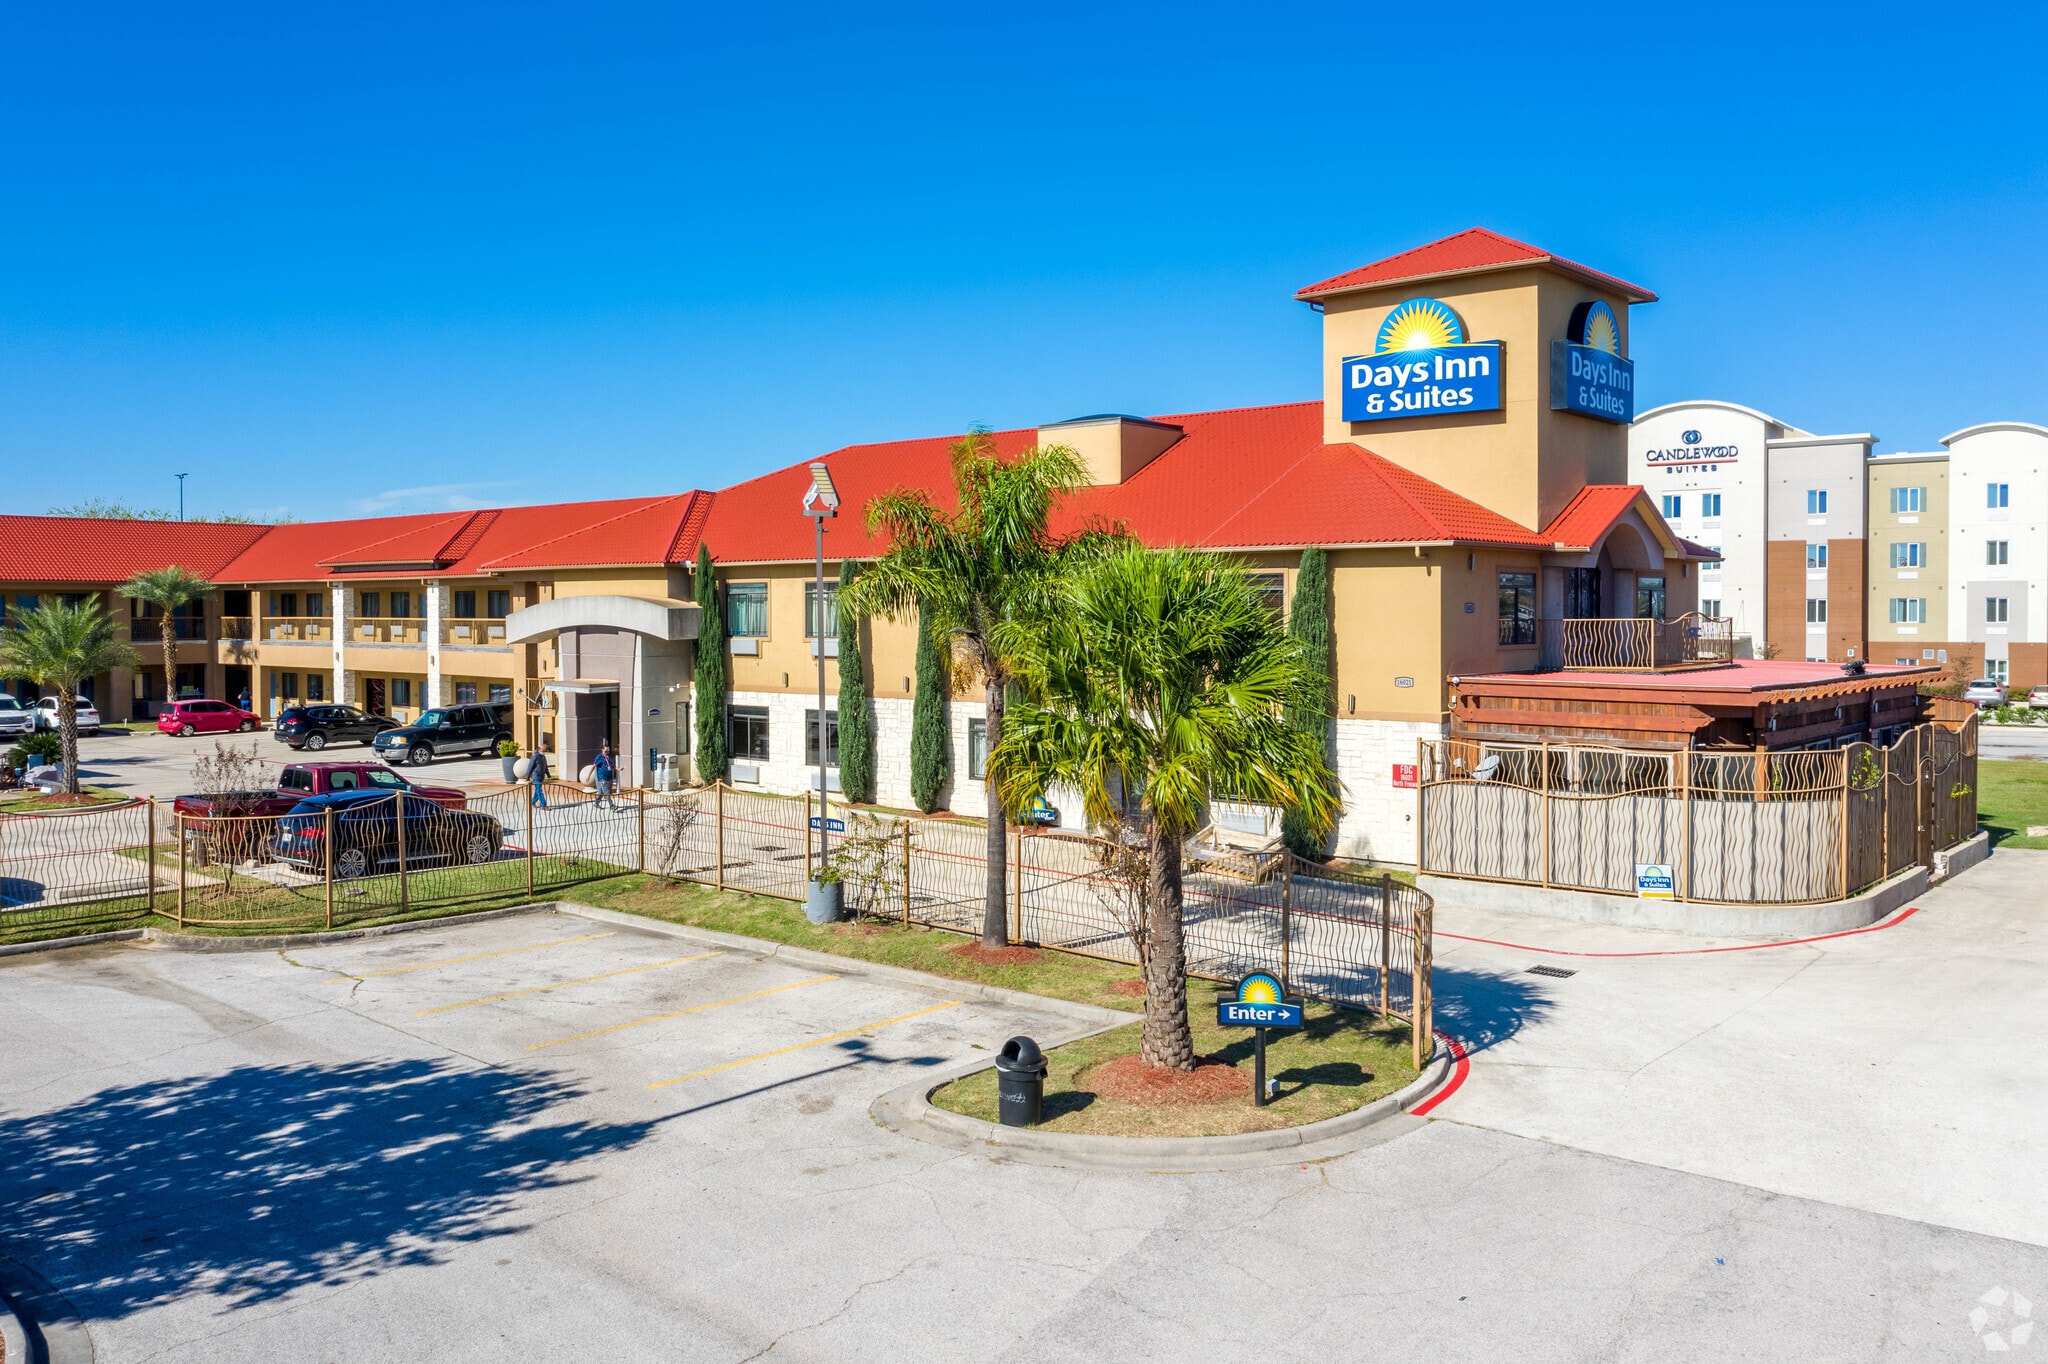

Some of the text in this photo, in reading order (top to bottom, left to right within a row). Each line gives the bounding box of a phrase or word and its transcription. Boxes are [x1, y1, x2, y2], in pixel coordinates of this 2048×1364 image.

[1351, 355, 1490, 389] Days Inn
[1571, 351, 1630, 391] Days Inn
[1366, 385, 1474, 414] & Suites
[1579, 386, 1625, 415] & Suites
[1646, 445, 1739, 461] CANDLEWOOD
[1666, 464, 1718, 474] SUITES
[1400, 765, 1413, 775] FDC
[811, 818, 844, 830] DAS INN
[1639, 876, 1657, 884] Days
[1228, 1006, 1276, 1020] Enter
